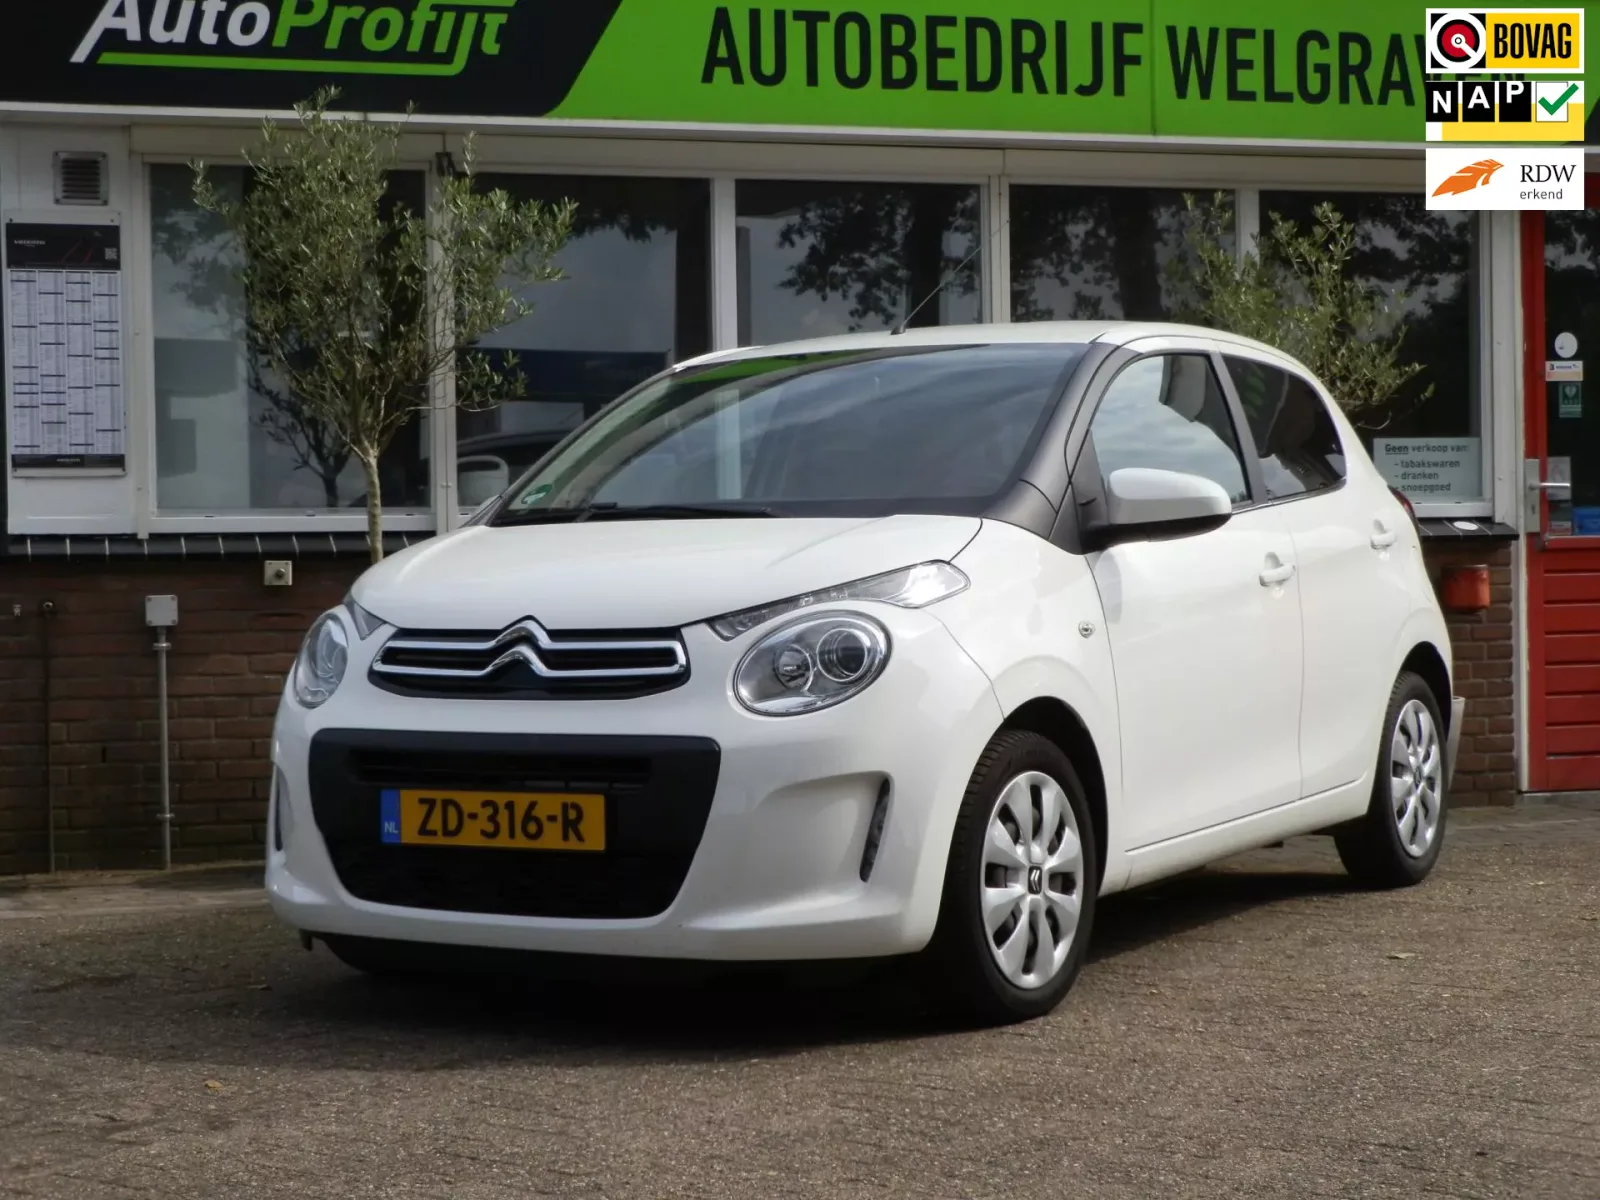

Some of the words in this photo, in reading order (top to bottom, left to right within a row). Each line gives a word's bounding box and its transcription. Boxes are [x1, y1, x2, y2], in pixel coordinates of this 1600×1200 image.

[700, 6, 1143, 98] AUTOBEDRIJF
[1166, 24, 1526, 107] WELGRA
[1385, 443, 1409, 455] Geen
[1411, 443, 1448, 454] verkoop
[1401, 471, 1439, 480] dranken
[1401, 483, 1452, 494] snoepgoed
[417, 797, 585, 842] ZD-316-R
[384, 821, 399, 834] NL
